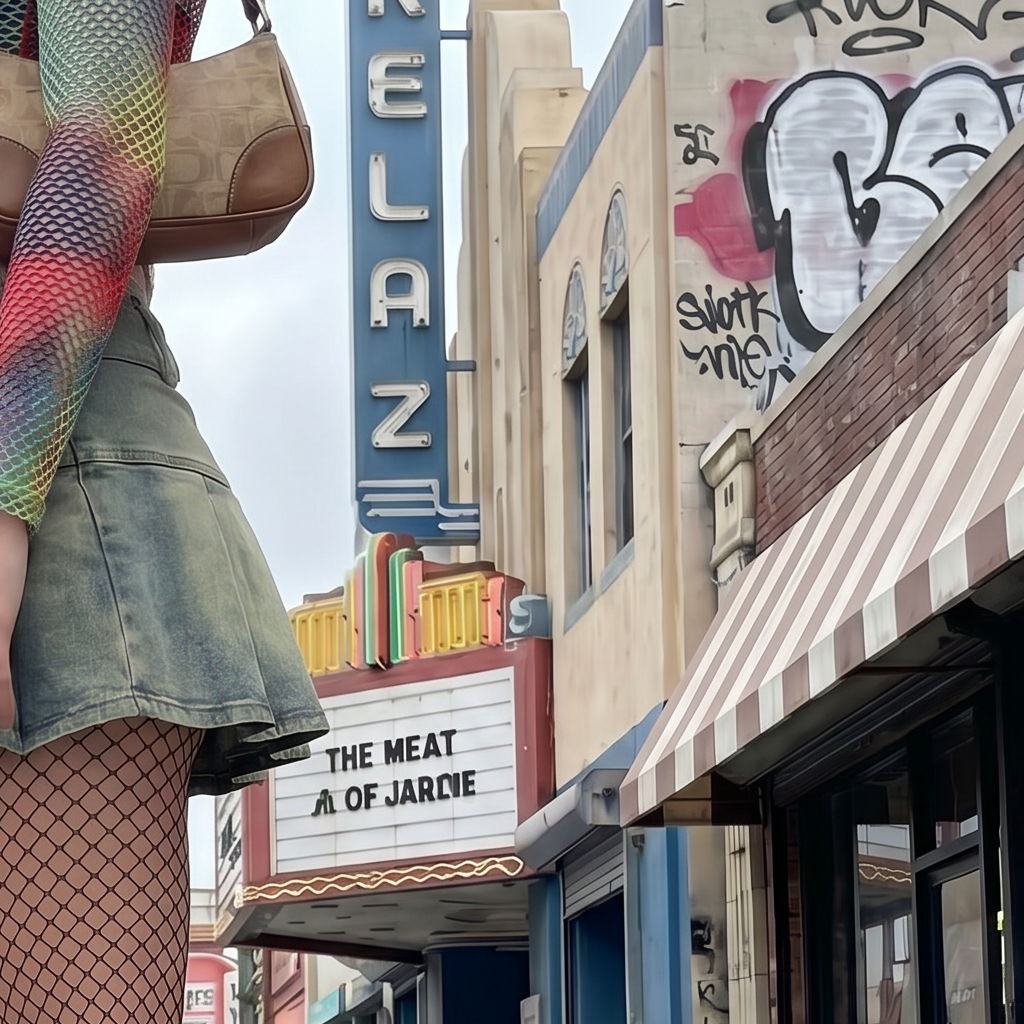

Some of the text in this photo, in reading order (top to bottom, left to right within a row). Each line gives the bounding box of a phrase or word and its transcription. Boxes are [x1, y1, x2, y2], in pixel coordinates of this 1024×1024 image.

[325, 728, 457, 773] THE MEAT
[344, 782, 379, 812] OF
